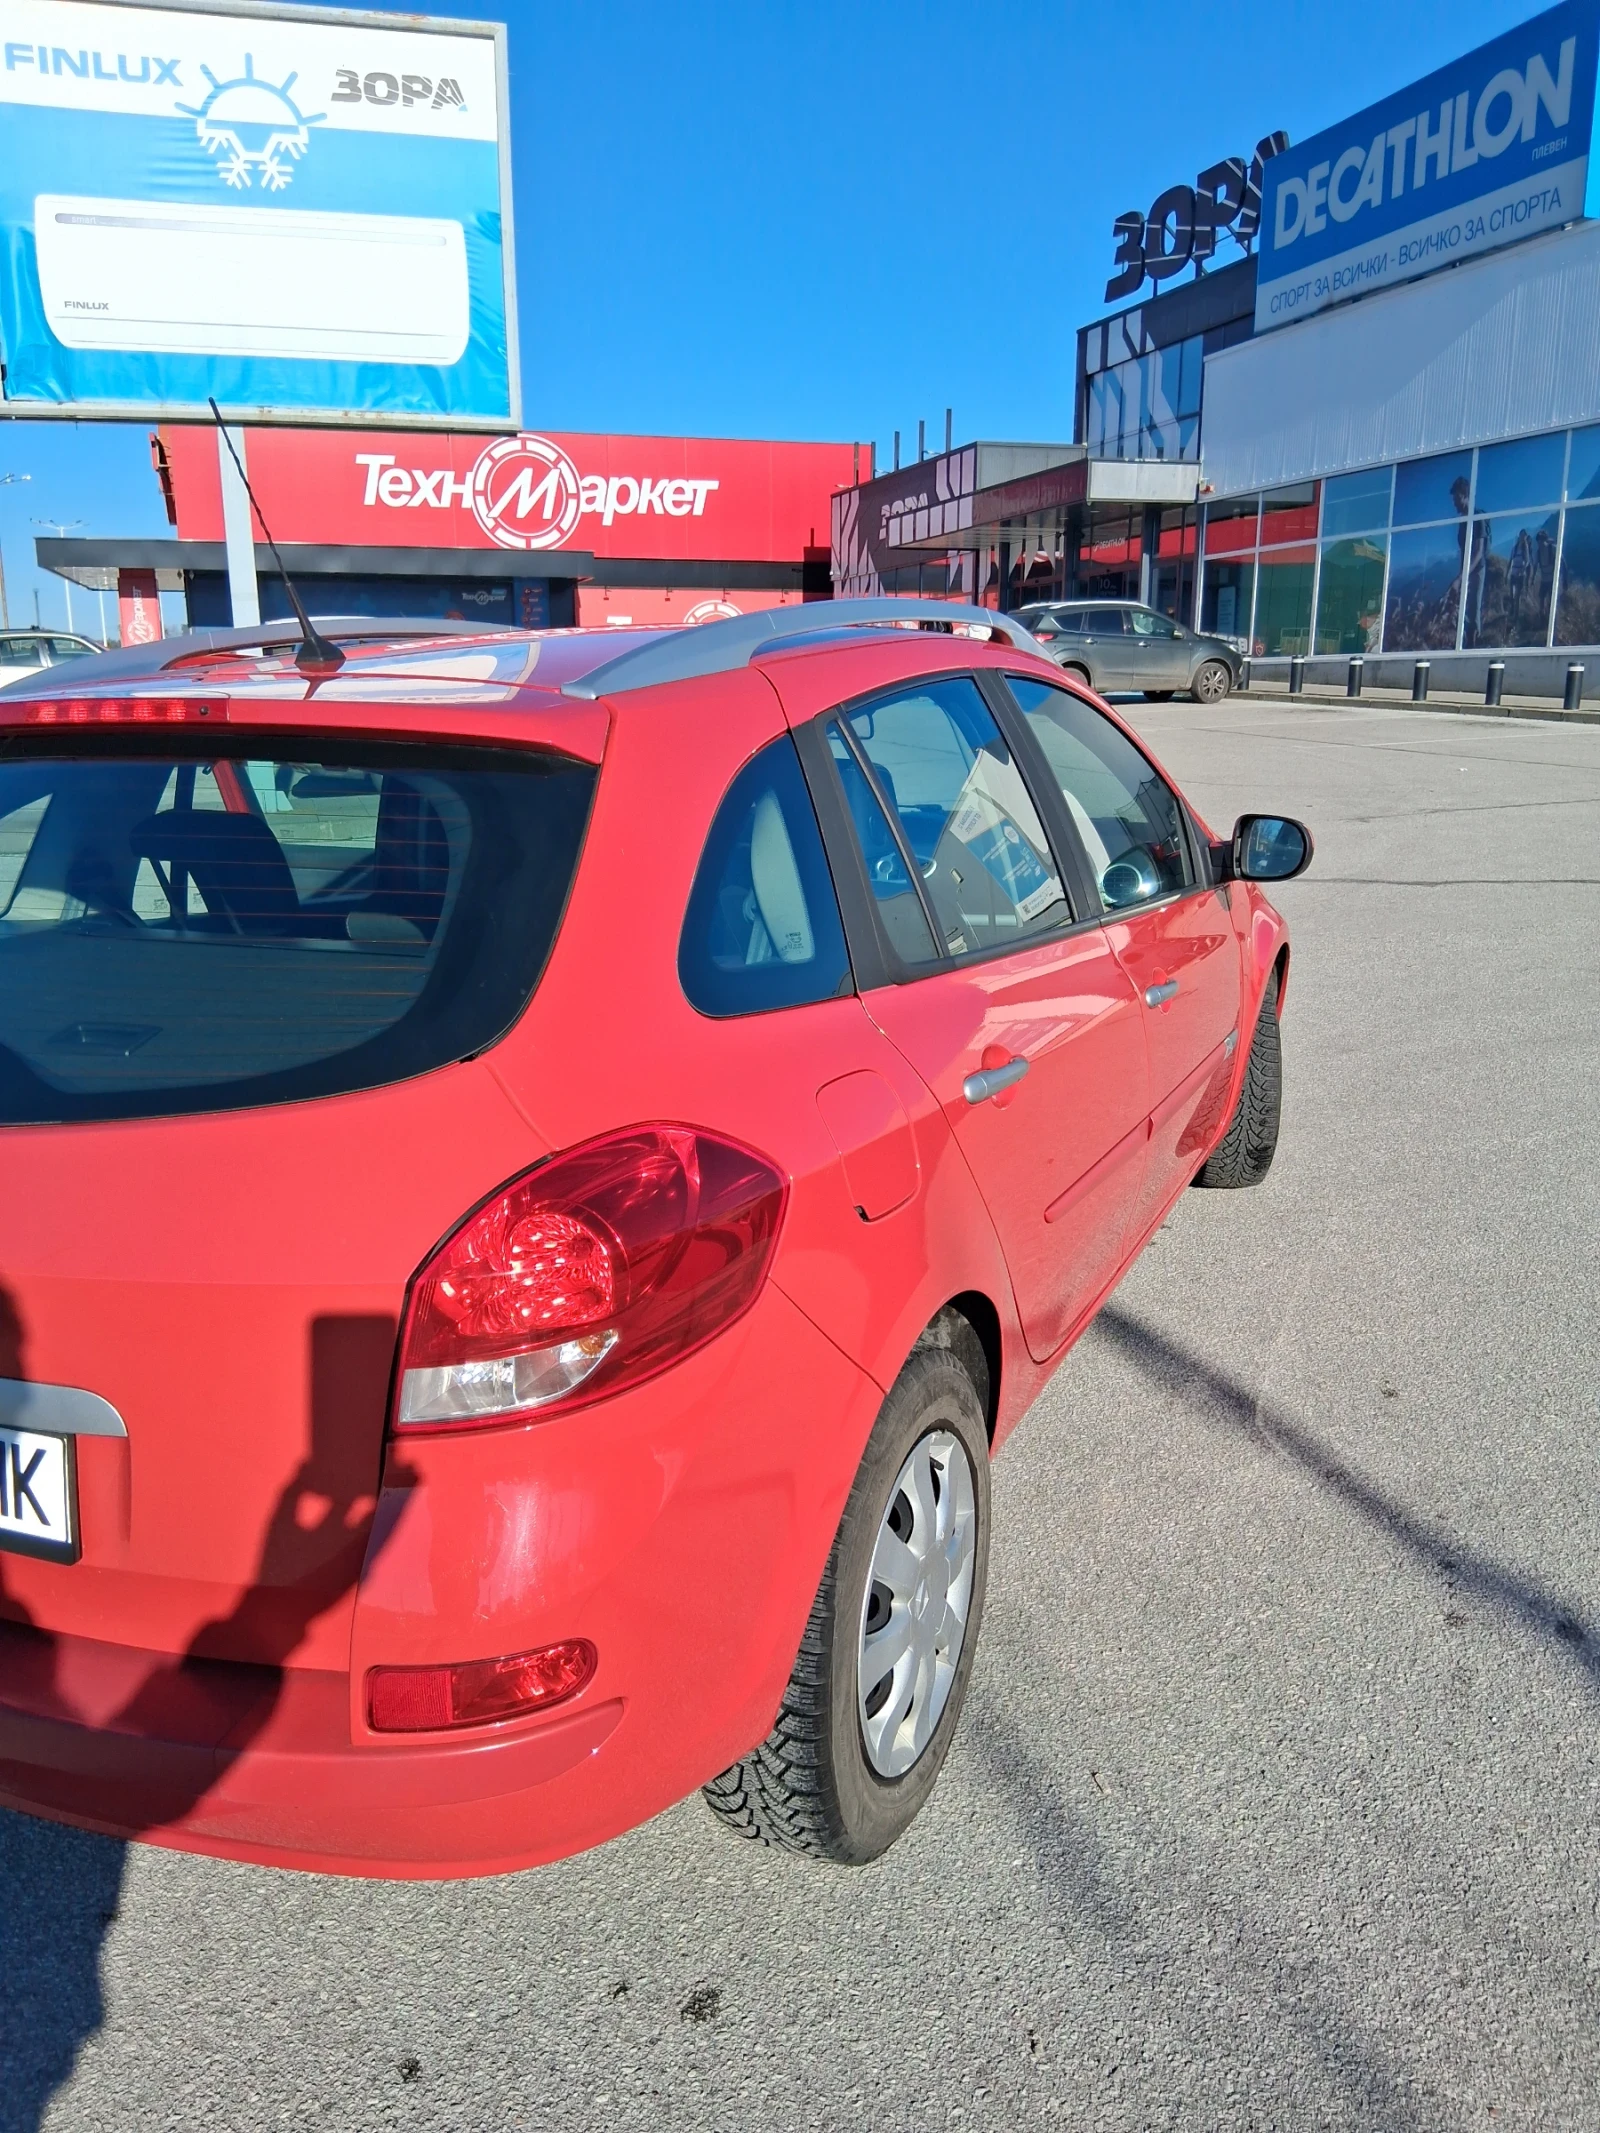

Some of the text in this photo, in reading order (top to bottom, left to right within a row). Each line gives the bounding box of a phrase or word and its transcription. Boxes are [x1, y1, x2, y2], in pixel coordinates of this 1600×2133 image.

[5, 42, 184, 87] FINLUX
[331, 69, 467, 111] ЗОРА
[1274, 36, 1577, 251] DECATHLON
[1532, 136, 1568, 161] ПЛЕВЕН
[1270, 282, 1313, 314] СПОРТ
[1313, 275, 1330, 298] ЗА
[1333, 252, 1388, 292] ВСИЧКИ
[1398, 225, 1461, 267] ВСИЧКО
[1464, 219, 1486, 243] ЗА
[1489, 187, 1562, 232] СПОРТА
[64, 300, 110, 311] FINLUX
